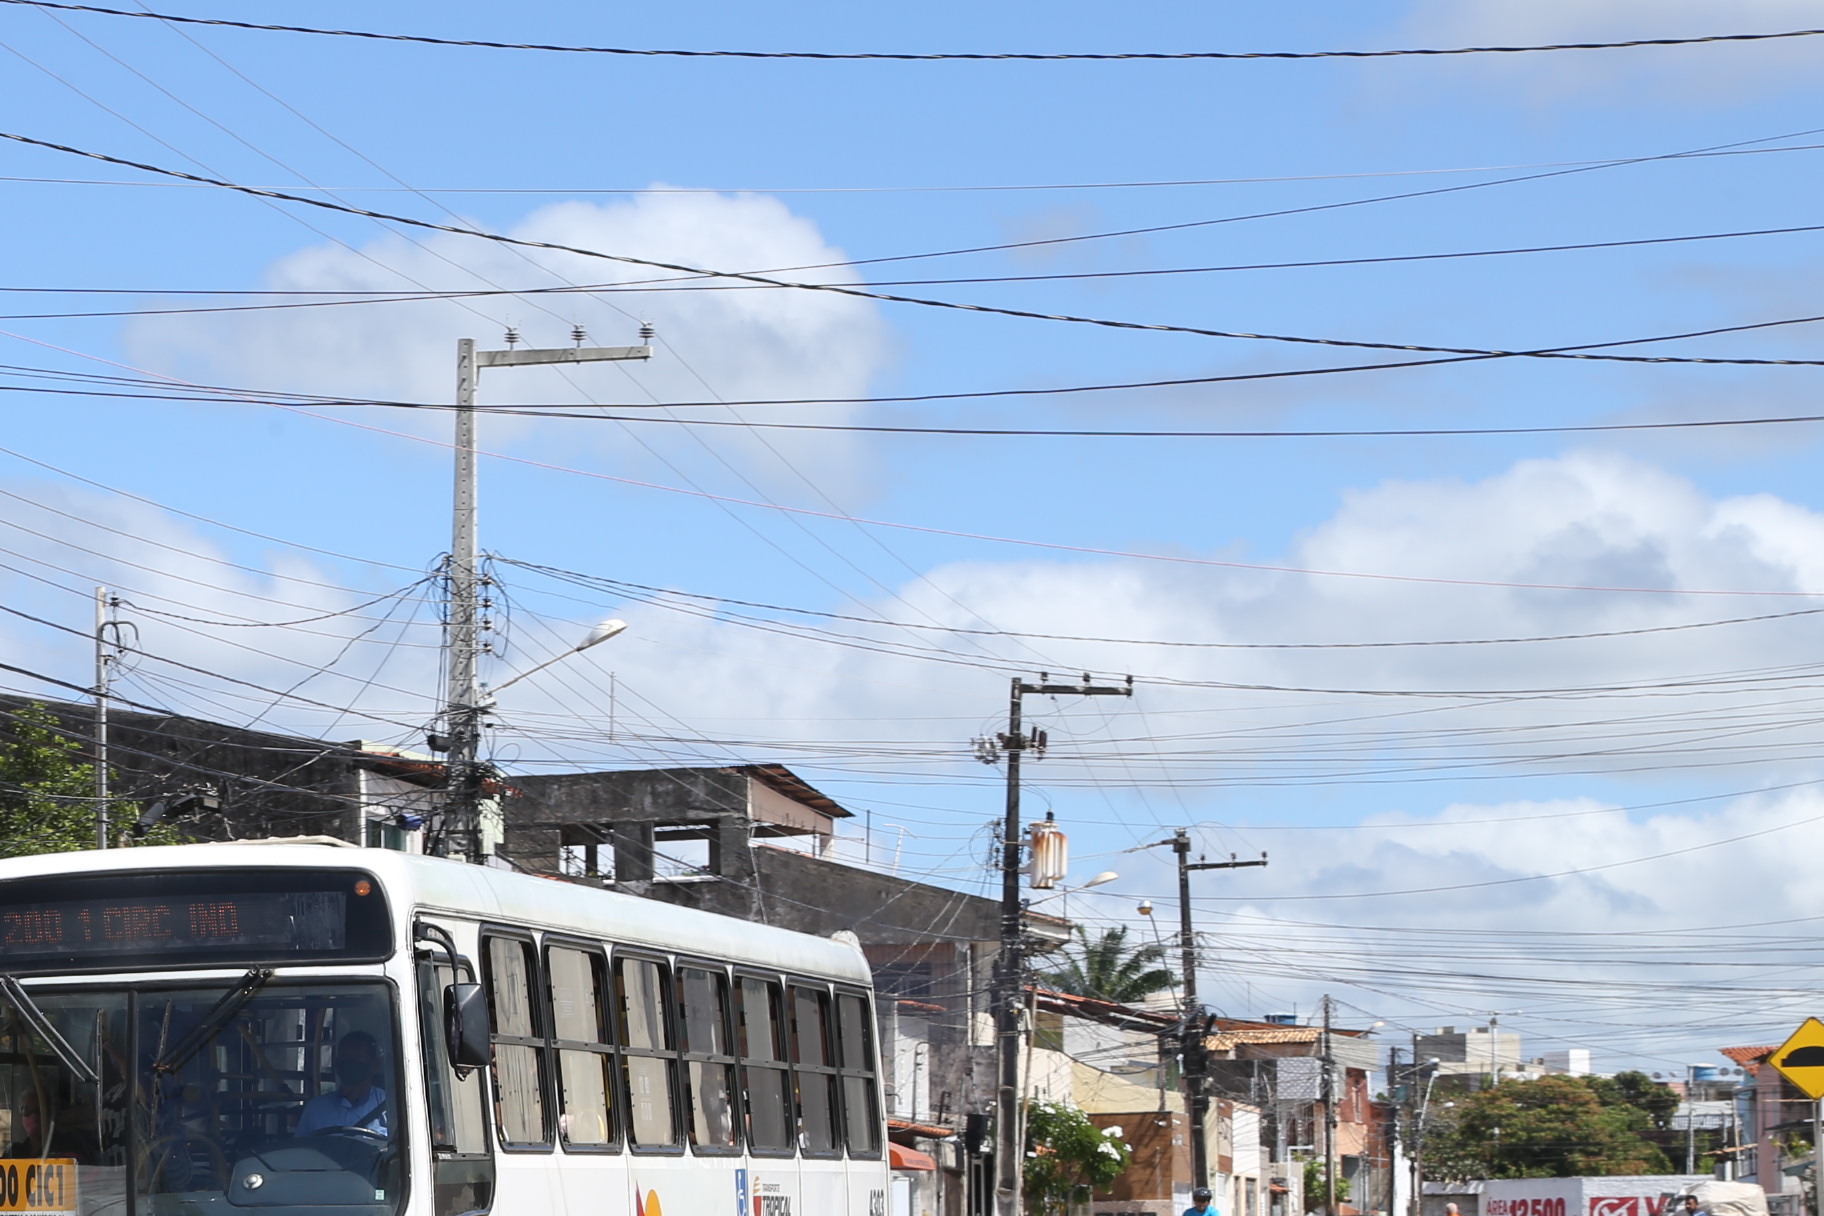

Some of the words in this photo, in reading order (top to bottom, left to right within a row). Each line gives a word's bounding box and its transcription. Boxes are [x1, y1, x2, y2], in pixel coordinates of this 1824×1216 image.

[3, 910, 62, 944] 200
[102, 904, 172, 942] CIRC
[762, 1195, 791, 1216] TROPICAL
